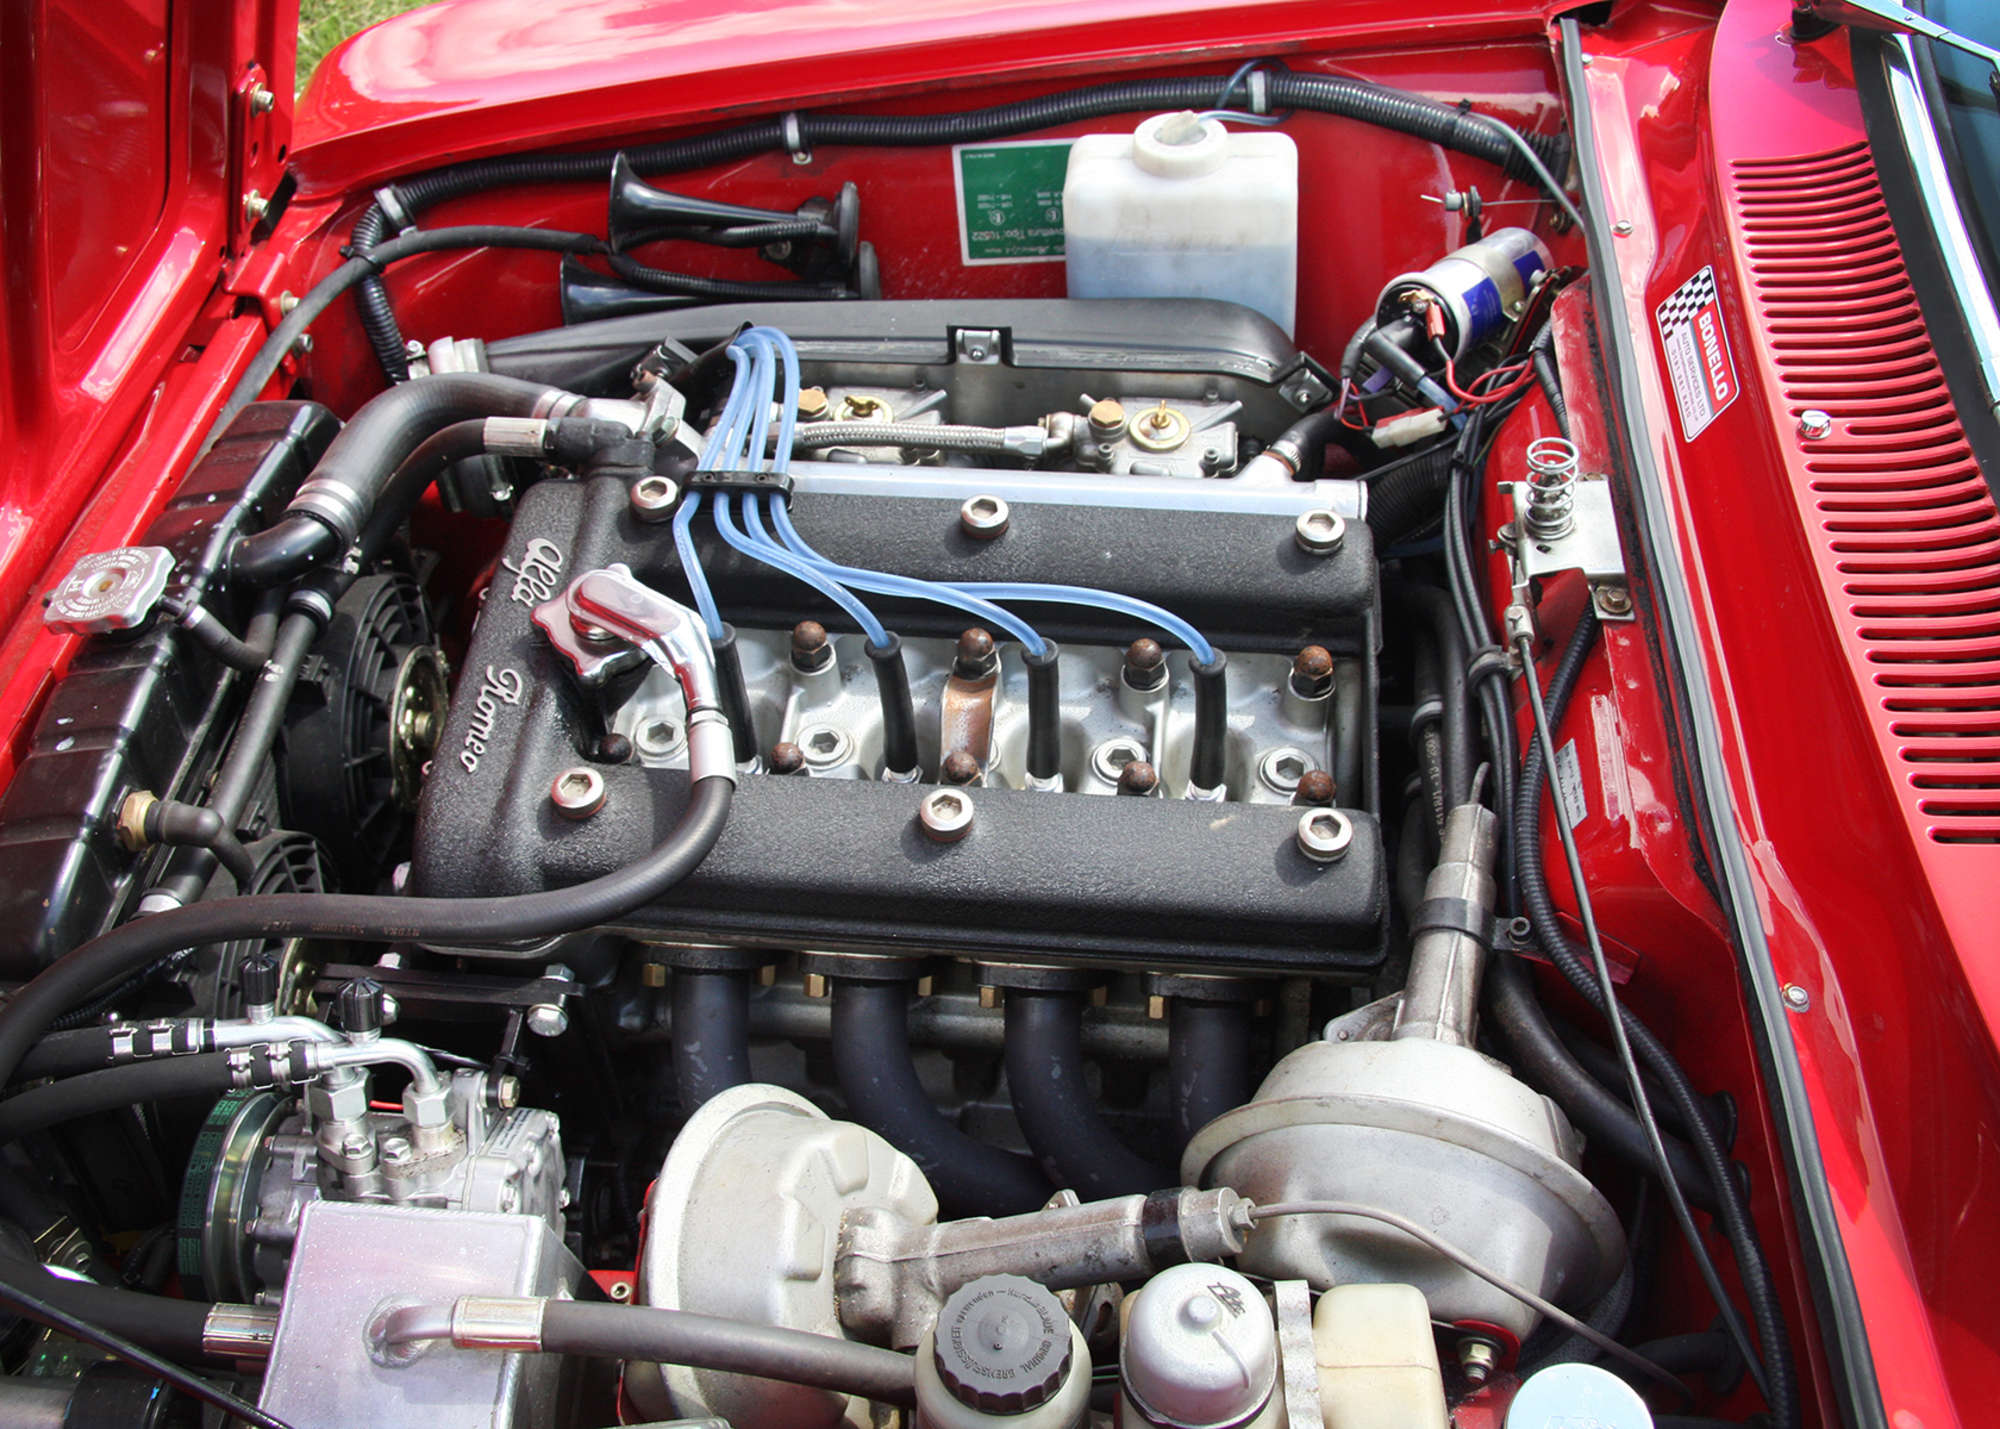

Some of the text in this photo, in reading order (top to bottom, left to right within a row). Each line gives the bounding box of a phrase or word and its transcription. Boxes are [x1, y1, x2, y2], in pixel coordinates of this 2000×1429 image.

[1681, 332, 1691, 356] AUTO
[1687, 355, 1702, 399] SERVICES
[1697, 398, 1706, 418] LTD
[1698, 311, 1729, 401] BONELLO
[460, 537, 563, 773] Alfa Romeo
